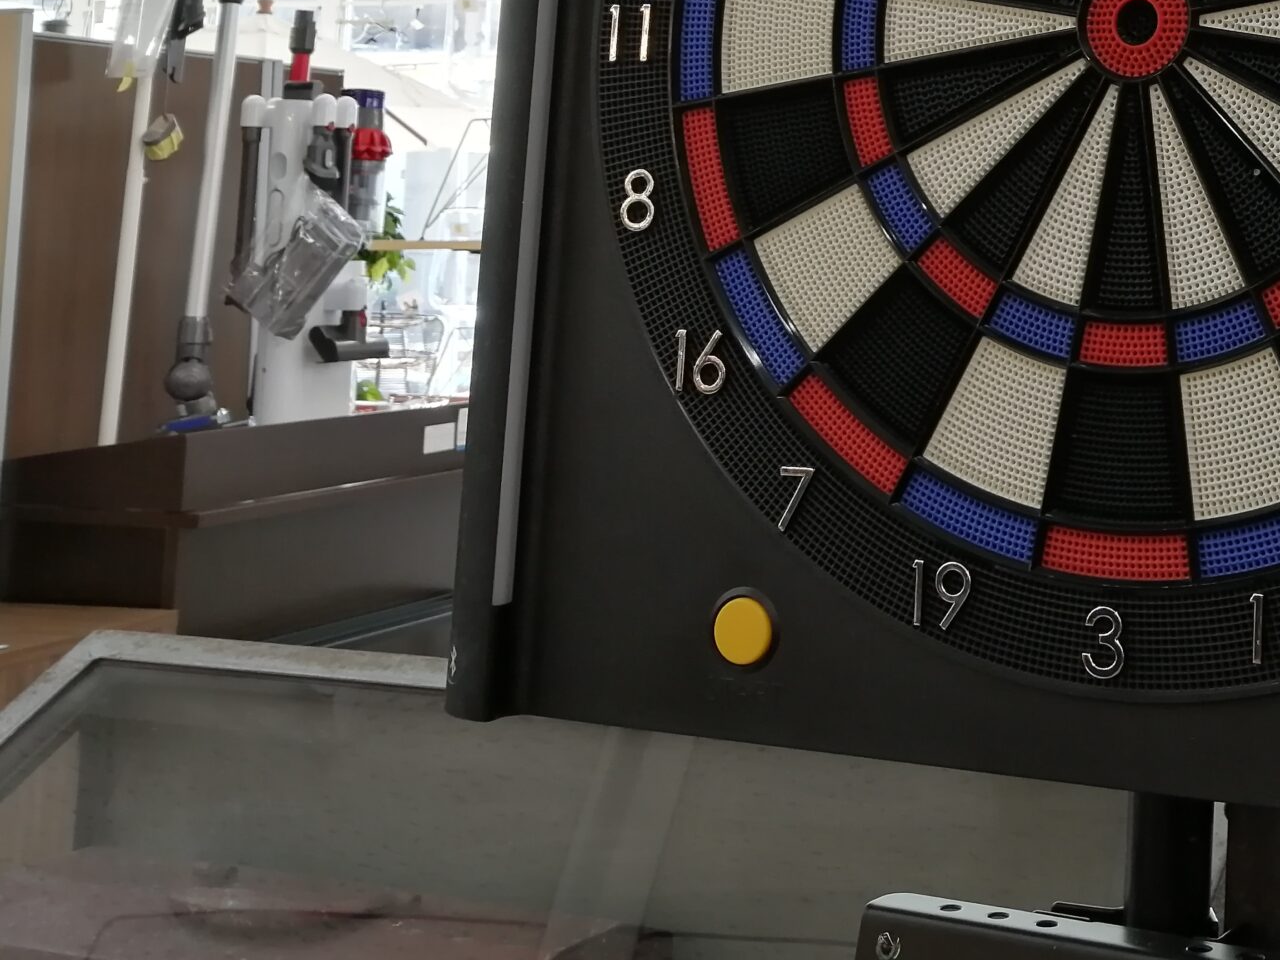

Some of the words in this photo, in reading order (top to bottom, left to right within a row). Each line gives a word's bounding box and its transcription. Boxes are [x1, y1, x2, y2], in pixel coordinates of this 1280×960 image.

[608, 3, 651, 62] 11
[620, 168, 655, 232] 8
[674, 329, 726, 395] 16
[780, 465, 815, 531] 7
[912, 559, 972, 630] 19
[1081, 605, 1125, 679] 3
